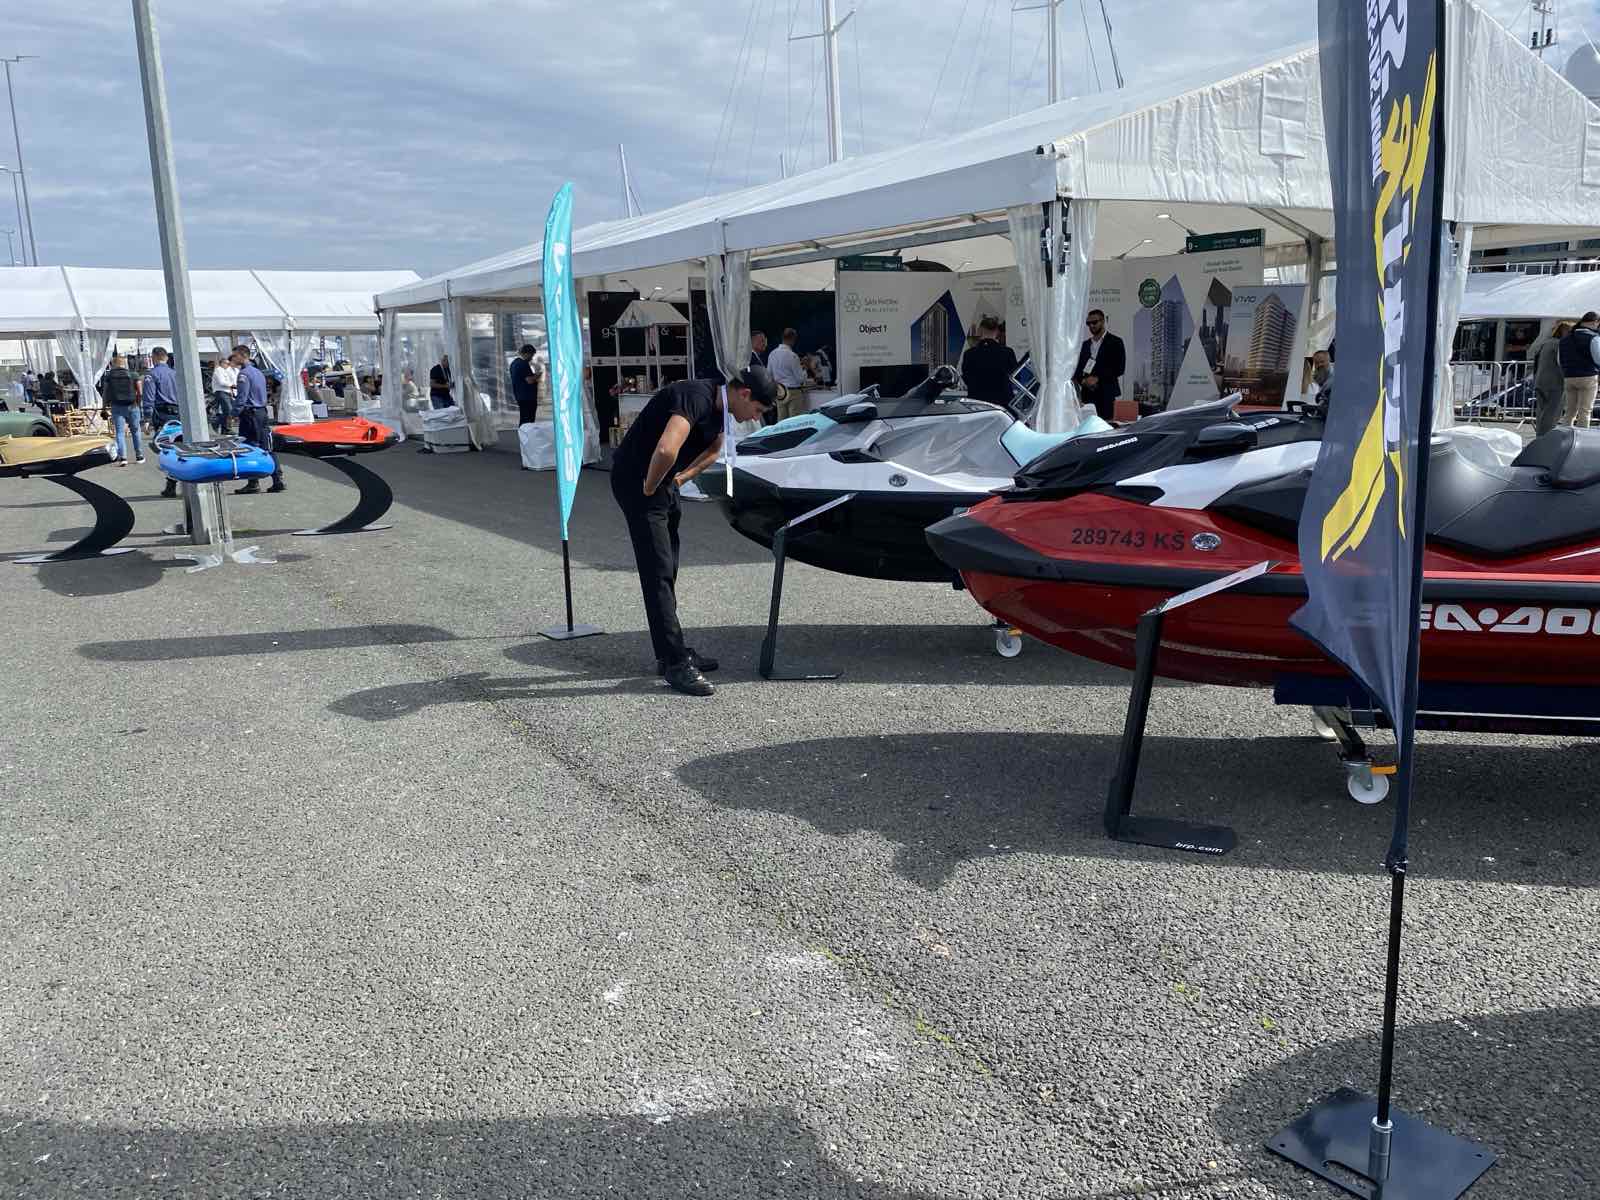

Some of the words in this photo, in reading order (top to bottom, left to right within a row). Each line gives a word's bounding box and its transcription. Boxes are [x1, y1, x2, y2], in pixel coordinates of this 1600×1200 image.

[859, 324, 881, 335] Object
[883, 324, 888, 333] 1
[1072, 528, 1146, 549] 289743
[1153, 530, 1184, 551] KŠ
[1175, 841, 1224, 854] brp.com
